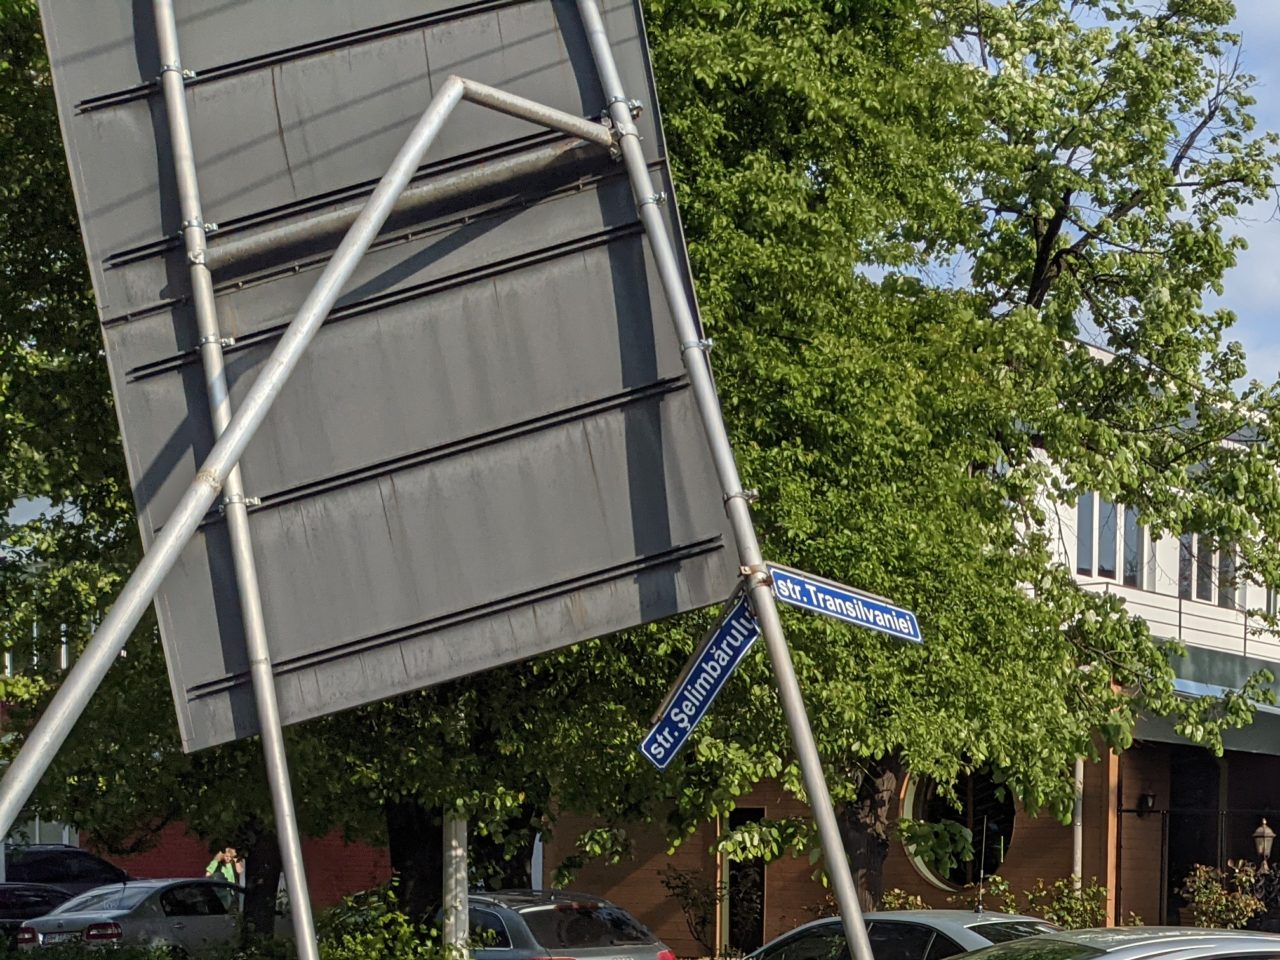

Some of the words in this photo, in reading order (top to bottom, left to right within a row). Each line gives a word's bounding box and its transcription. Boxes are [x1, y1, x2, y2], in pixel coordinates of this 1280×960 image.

[777, 579, 808, 602] str.
[805, 583, 914, 635] Transilvaniei
[650, 727, 679, 759] str.
